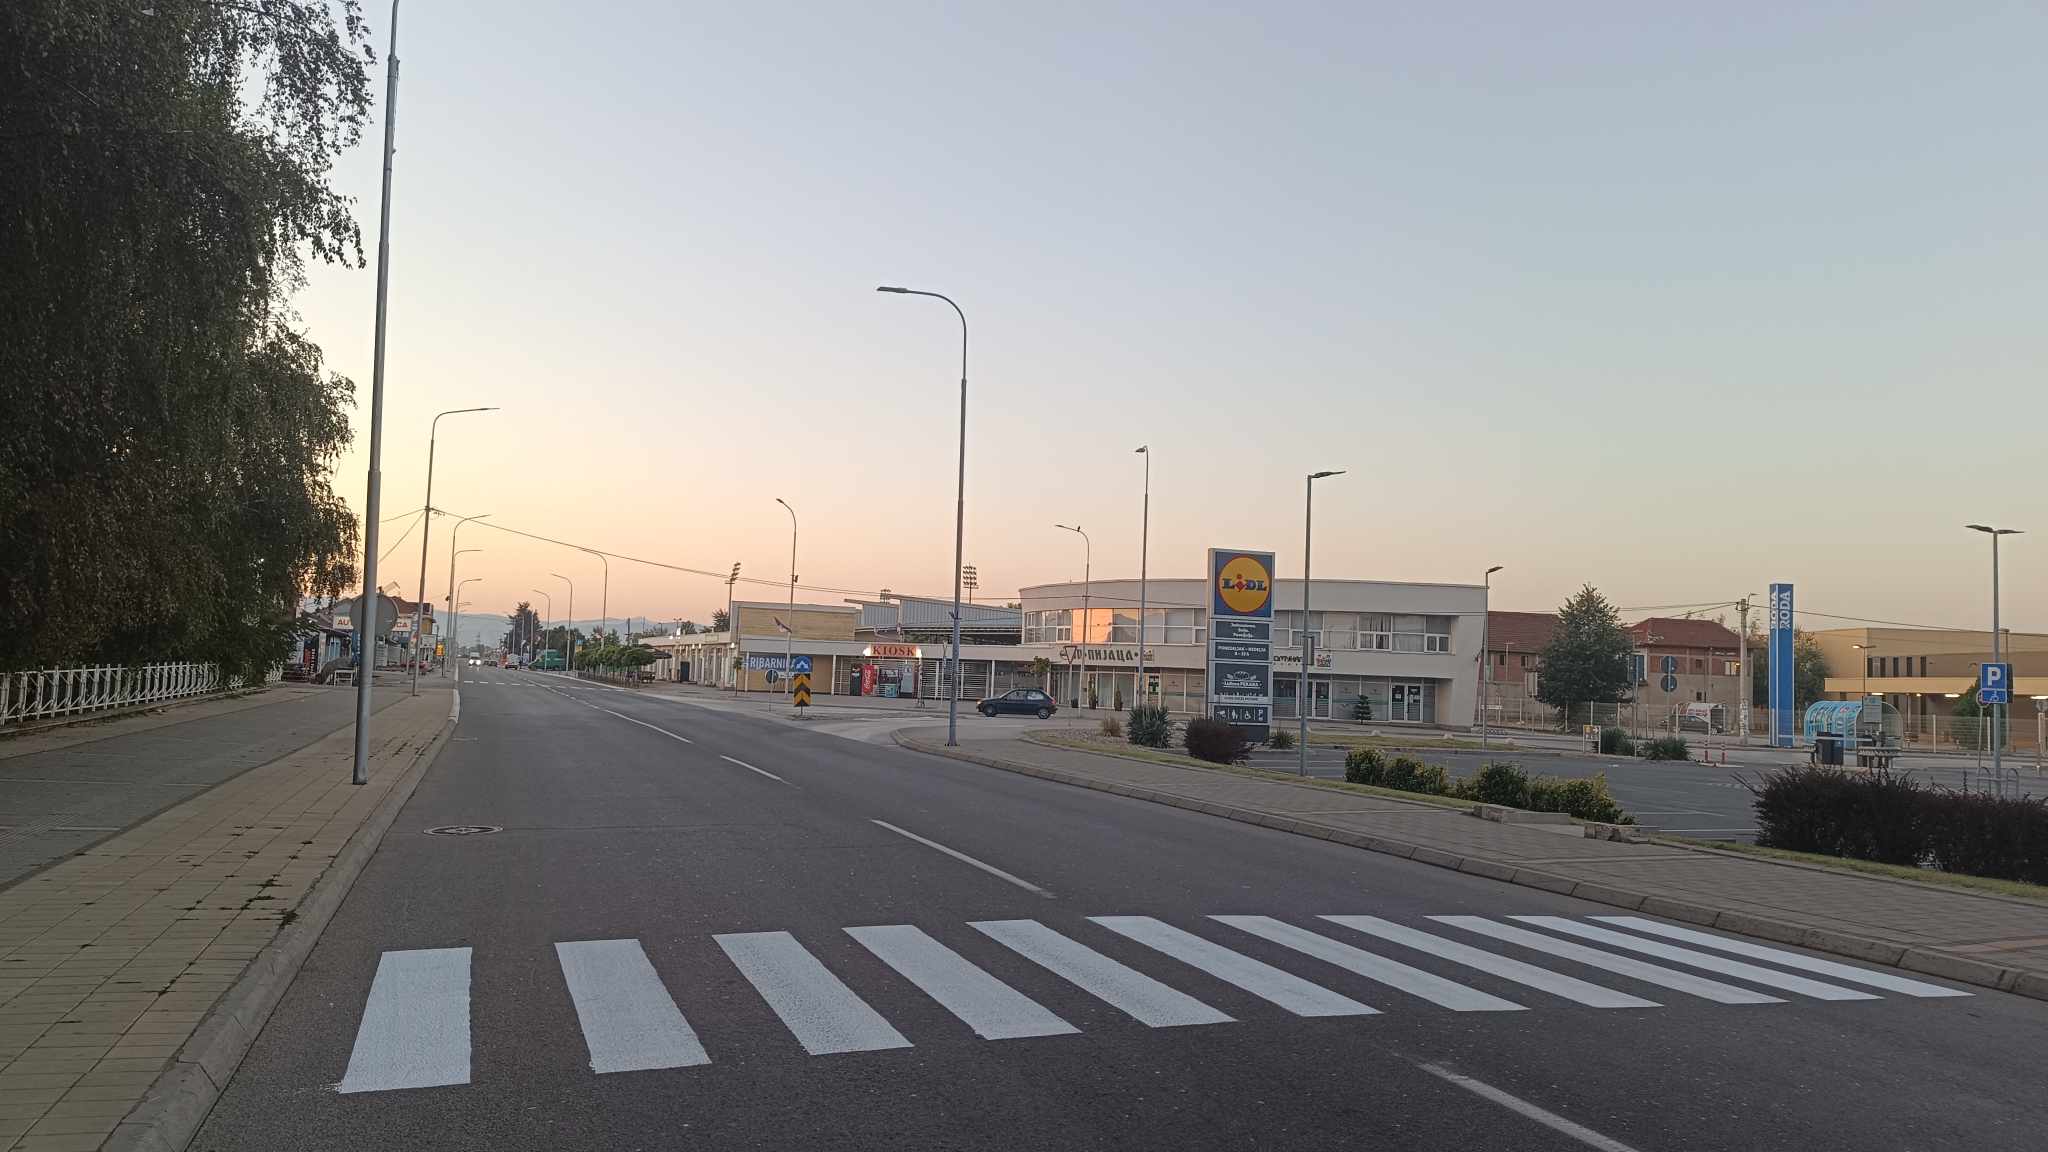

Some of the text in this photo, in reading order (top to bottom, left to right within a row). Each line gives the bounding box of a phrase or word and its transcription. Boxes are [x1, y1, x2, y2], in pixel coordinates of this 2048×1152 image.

[1222, 574, 1267, 592] LIDL
[1779, 591, 1791, 631] RODA
[873, 646, 914, 656] KIOSK
[749, 656, 796, 669] RIBARNIA
[1988, 666, 2001, 686] P
